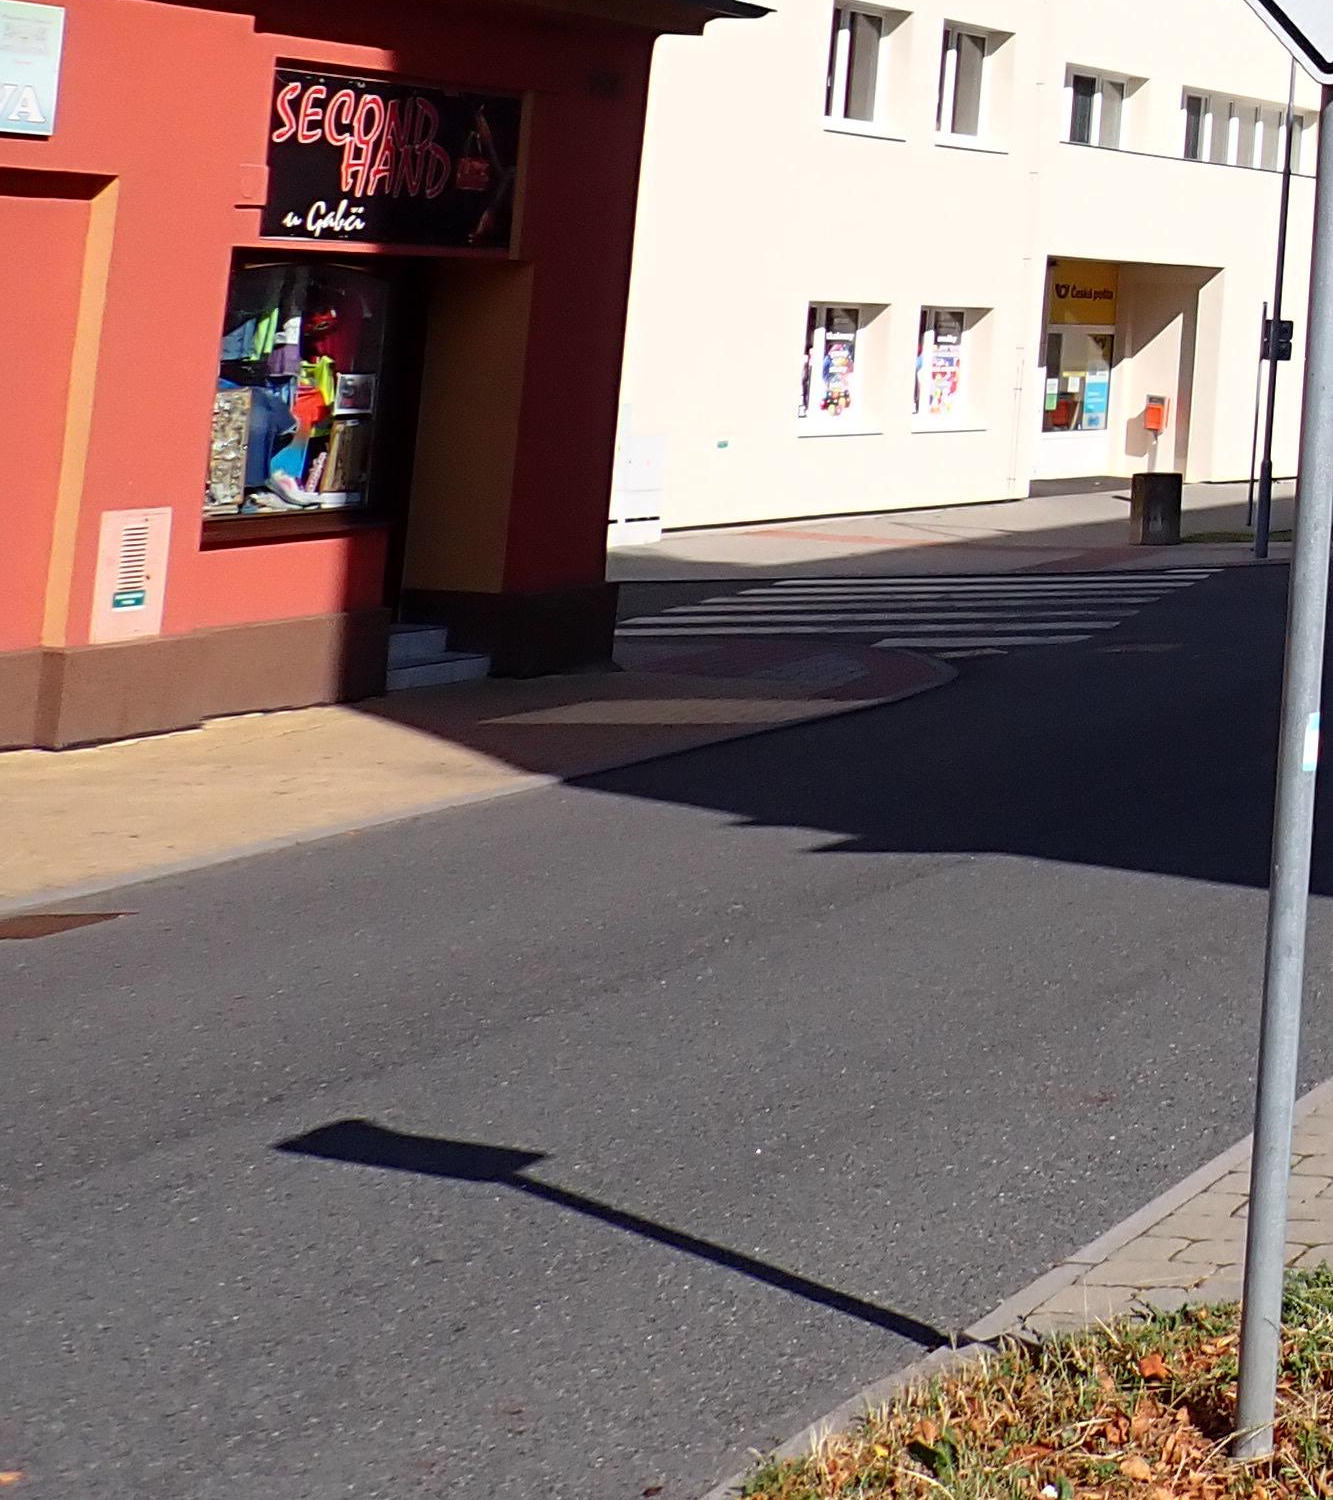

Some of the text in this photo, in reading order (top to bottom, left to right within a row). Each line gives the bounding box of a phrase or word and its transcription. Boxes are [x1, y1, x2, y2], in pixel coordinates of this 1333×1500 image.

[272, 82, 439, 147] SECOND
[341, 137, 450, 198] HAND
[282, 211, 303, 227] u
